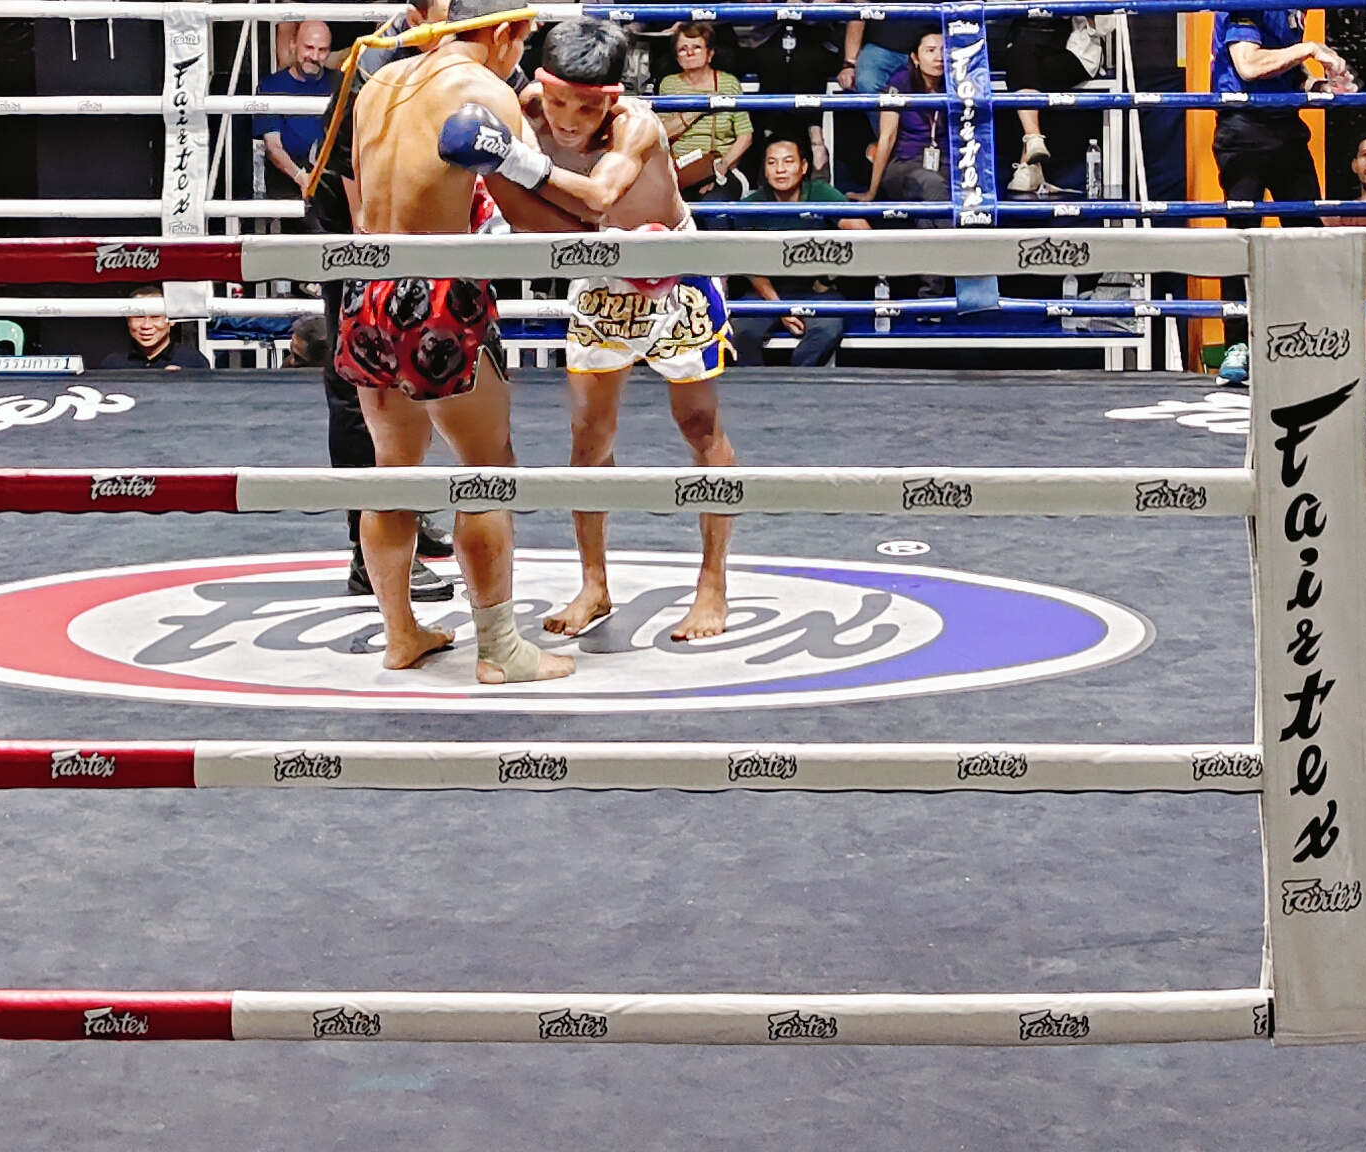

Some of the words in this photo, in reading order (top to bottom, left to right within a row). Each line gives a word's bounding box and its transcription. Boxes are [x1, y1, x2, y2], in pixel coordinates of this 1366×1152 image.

[94, 243, 160, 273] Fairtex
[321, 241, 390, 270] Fairtex
[550, 240, 619, 269] Fairtex
[782, 237, 853, 267] Fairtex
[1018, 237, 1090, 268] Fairtex
[1265, 322, 1352, 363] Fairtex
[90, 474, 156, 501] Fairtex
[449, 474, 517, 504] Fairtex
[675, 475, 743, 505] Fairtex
[902, 476, 972, 509] Fairtex
[1135, 479, 1206, 512] Fairtex
[1269, 378, 1360, 863] Fairtex
[50, 749, 116, 779] Fairtex
[273, 749, 341, 782] Fairtex
[498, 749, 567, 782] Fairtex
[727, 748, 797, 781] Fairtex
[956, 748, 1027, 781] Fairtex
[1191, 748, 1262, 780] Fairtex
[1282, 877, 1363, 916] Fairtex
[83, 1005, 149, 1036] Fairtex
[312, 1006, 381, 1038] Fairtex
[539, 1007, 608, 1040] Fairtex
[767, 1009, 838, 1041] Fairtex
[1019, 1009, 1090, 1041] Fairtex
